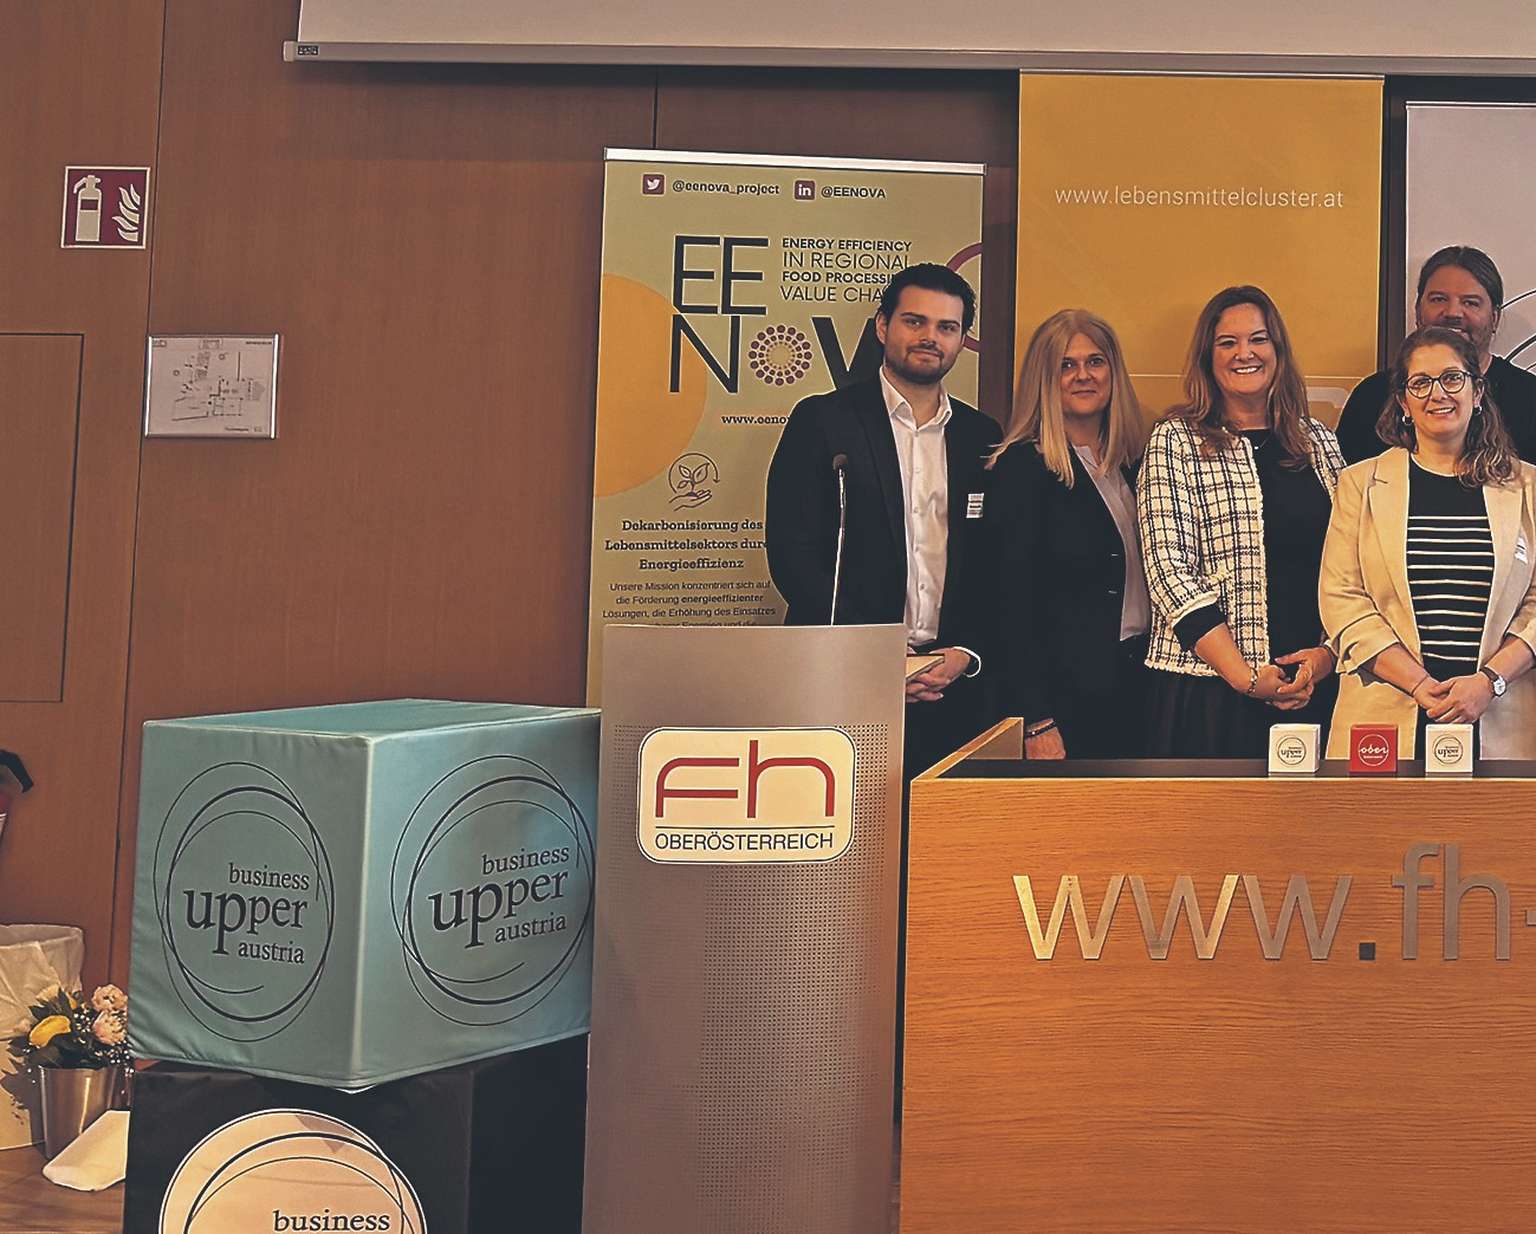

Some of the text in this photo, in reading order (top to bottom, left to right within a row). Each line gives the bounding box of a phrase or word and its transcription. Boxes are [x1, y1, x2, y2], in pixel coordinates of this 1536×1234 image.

[673, 180, 780, 196] @eenova_project
[821, 186, 886, 199] @EENOVA
[1055, 186, 1344, 208] www.lebensmittelcluster.at
[782, 237, 912, 251] ENERGY EFFICIENCY
[783, 251, 909, 270] IN REGIONAL
[673, 235, 769, 315] EE
[782, 271, 892, 284] FOOD PROCESSI
[780, 285, 883, 303] VALUE CHA
[720, 415, 790, 425] www.eeno
[622, 519, 764, 533] Dekarbonisierung des
[604, 538, 767, 551] Lebensmittelsektors dur
[638, 558, 745, 573] Energieeffizienz
[609, 582, 643, 592] Unsere
[645, 582, 680, 591] Mission
[681, 581, 735, 591] konzentriert
[736, 580, 755, 590] sich
[615, 593, 764, 606] die Förderung energieeffizienter
[652, 608, 666, 618] die
[668, 608, 713, 618] Erhöhung
[714, 607, 731, 617] des
[733, 606, 776, 617] Einsatzes
[655, 831, 834, 851] OBERÖSTERREICH
[481, 846, 570, 876] business
[228, 862, 310, 891] business
[427, 870, 569, 950] upper
[183, 890, 308, 955] upper
[494, 911, 567, 943] austria
[238, 940, 305, 965] austria
[272, 1208, 390, 1232] business
